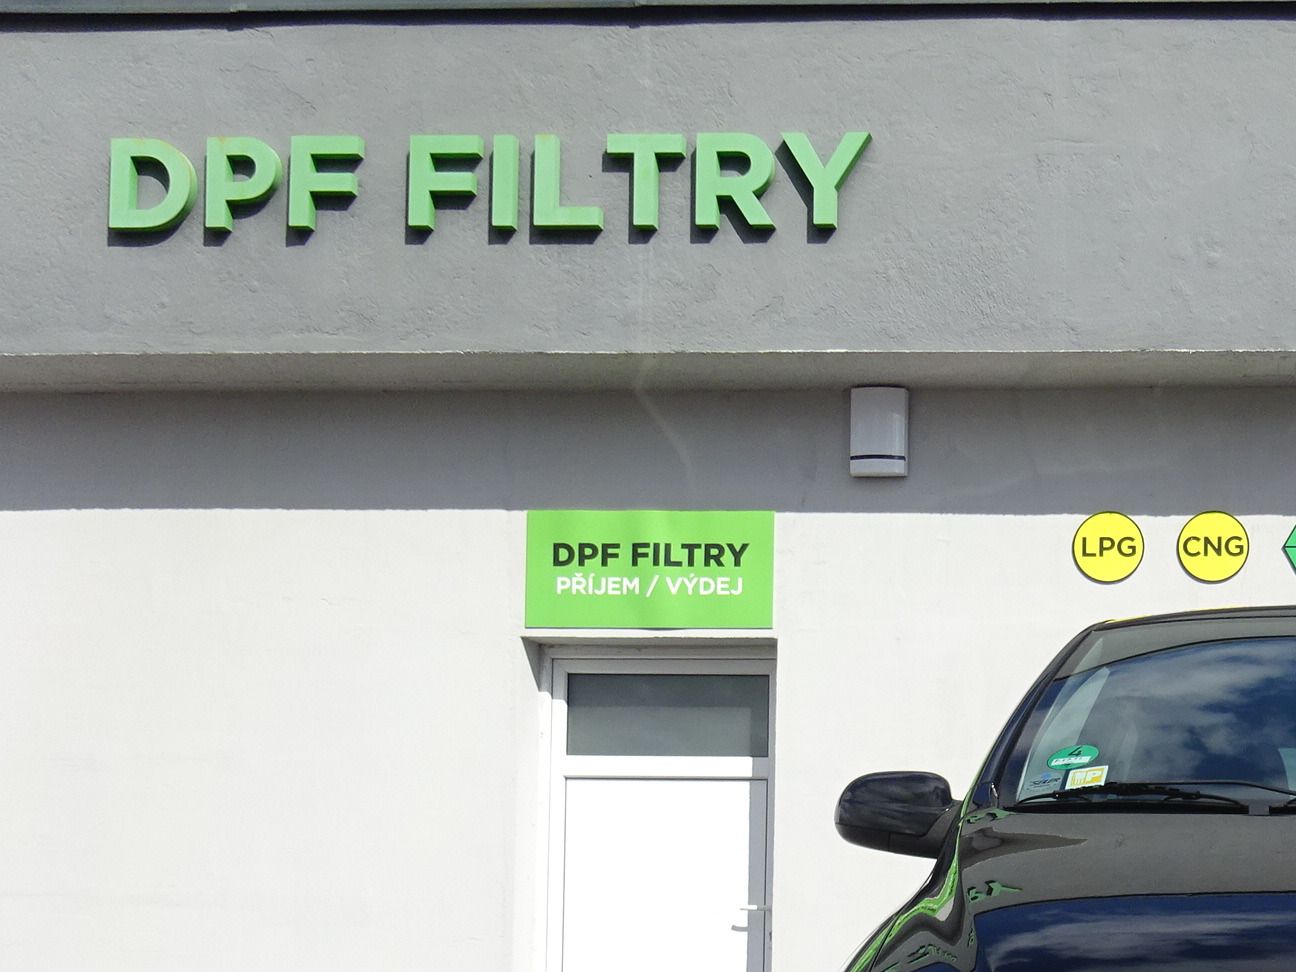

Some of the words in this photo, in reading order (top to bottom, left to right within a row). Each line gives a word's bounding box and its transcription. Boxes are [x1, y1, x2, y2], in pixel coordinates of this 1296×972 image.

[107, 135, 365, 232] DPF
[407, 131, 872, 231] FILTRY
[552, 542, 621, 567] DPF
[631, 542, 750, 568] FILTRY
[1082, 536, 1137, 557] LPG
[1182, 535, 1245, 557] CNG
[556, 573, 640, 595] PŘÍJEM
[645, 575, 659, 597] /
[665, 573, 743, 595] VÝDEJ
[1068, 746, 1082, 757] 4
